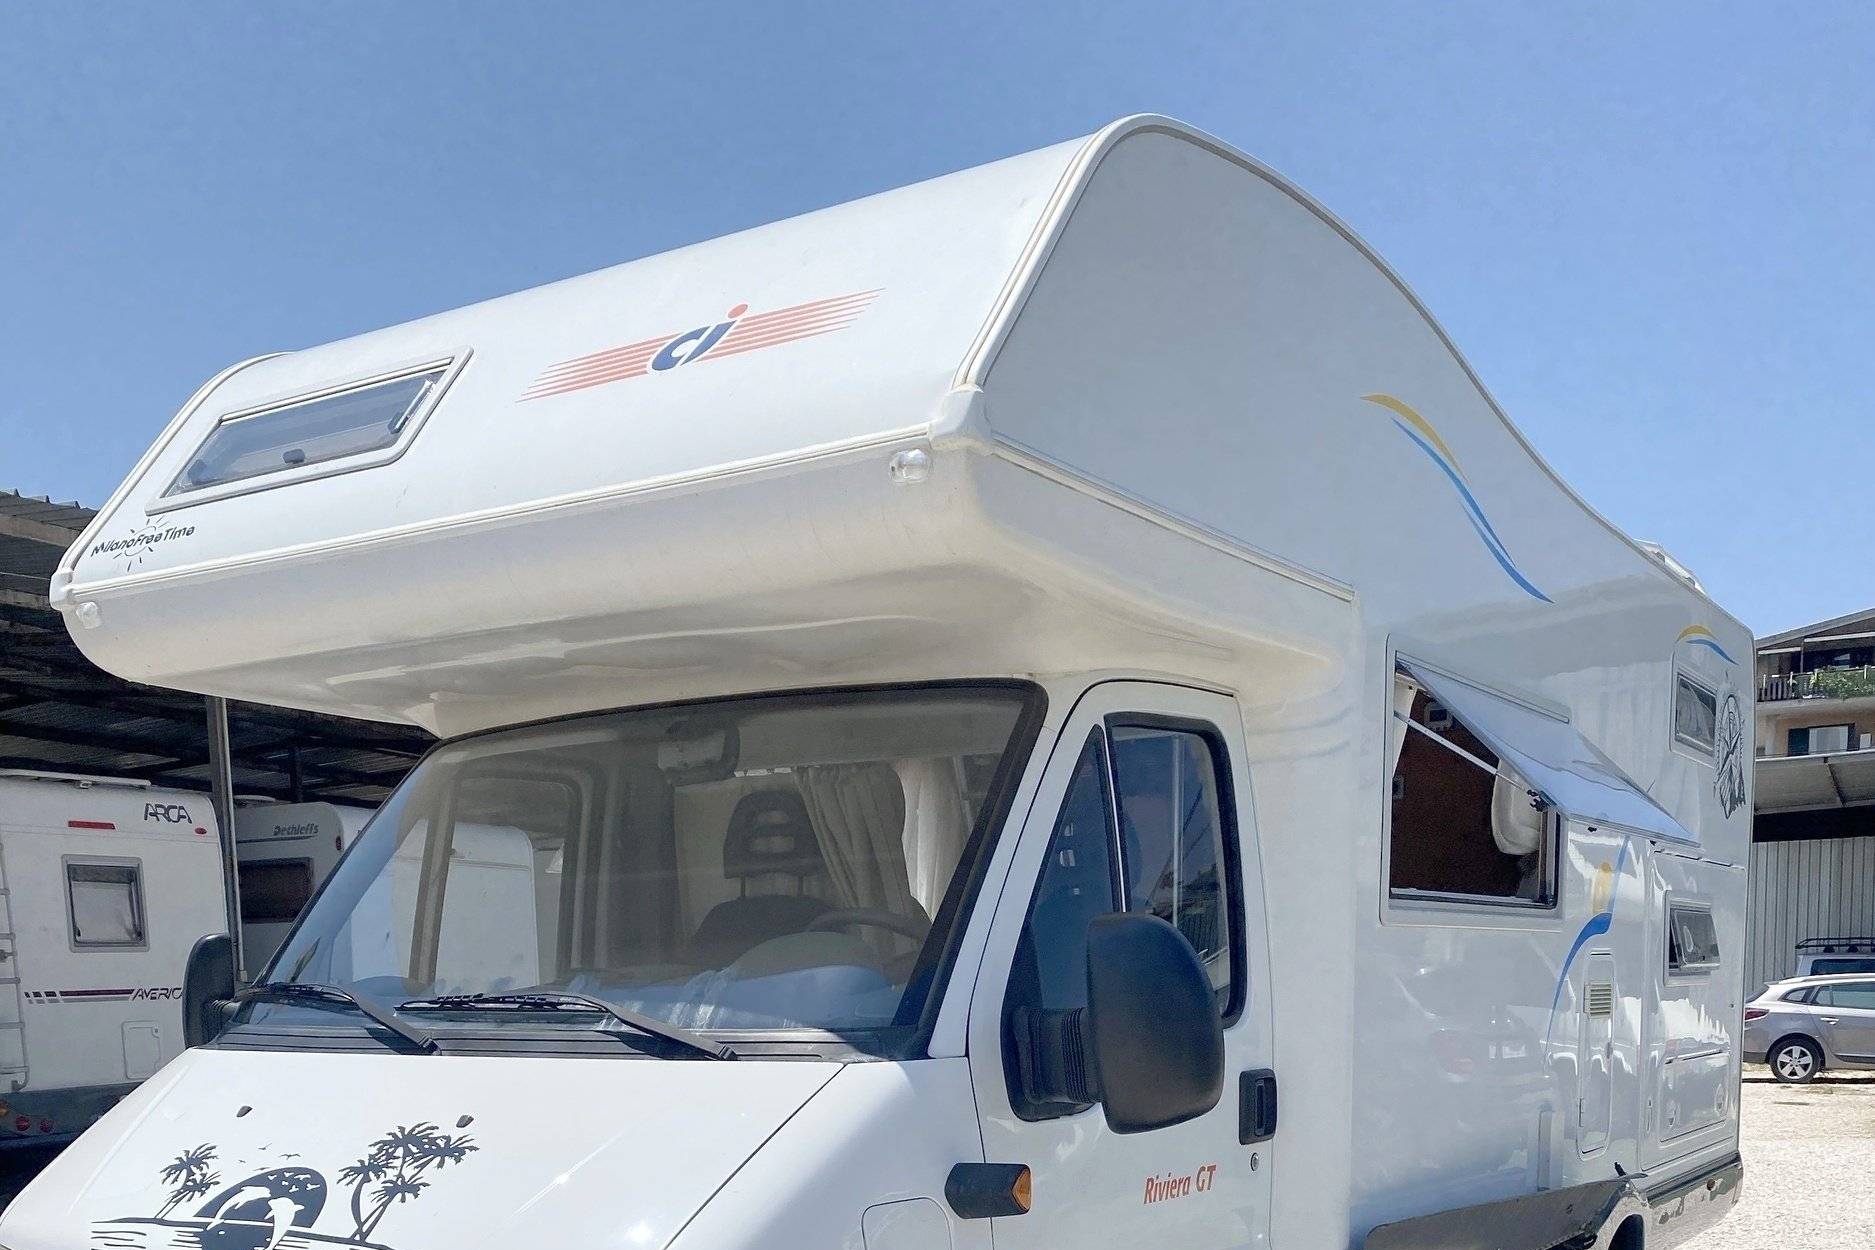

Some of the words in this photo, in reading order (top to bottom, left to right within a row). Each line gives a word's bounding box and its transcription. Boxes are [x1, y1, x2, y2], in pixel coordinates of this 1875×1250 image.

[143, 803, 193, 824] ARCA
[1143, 1171, 1192, 1205] Riviera
[1196, 1164, 1217, 1192] GT
